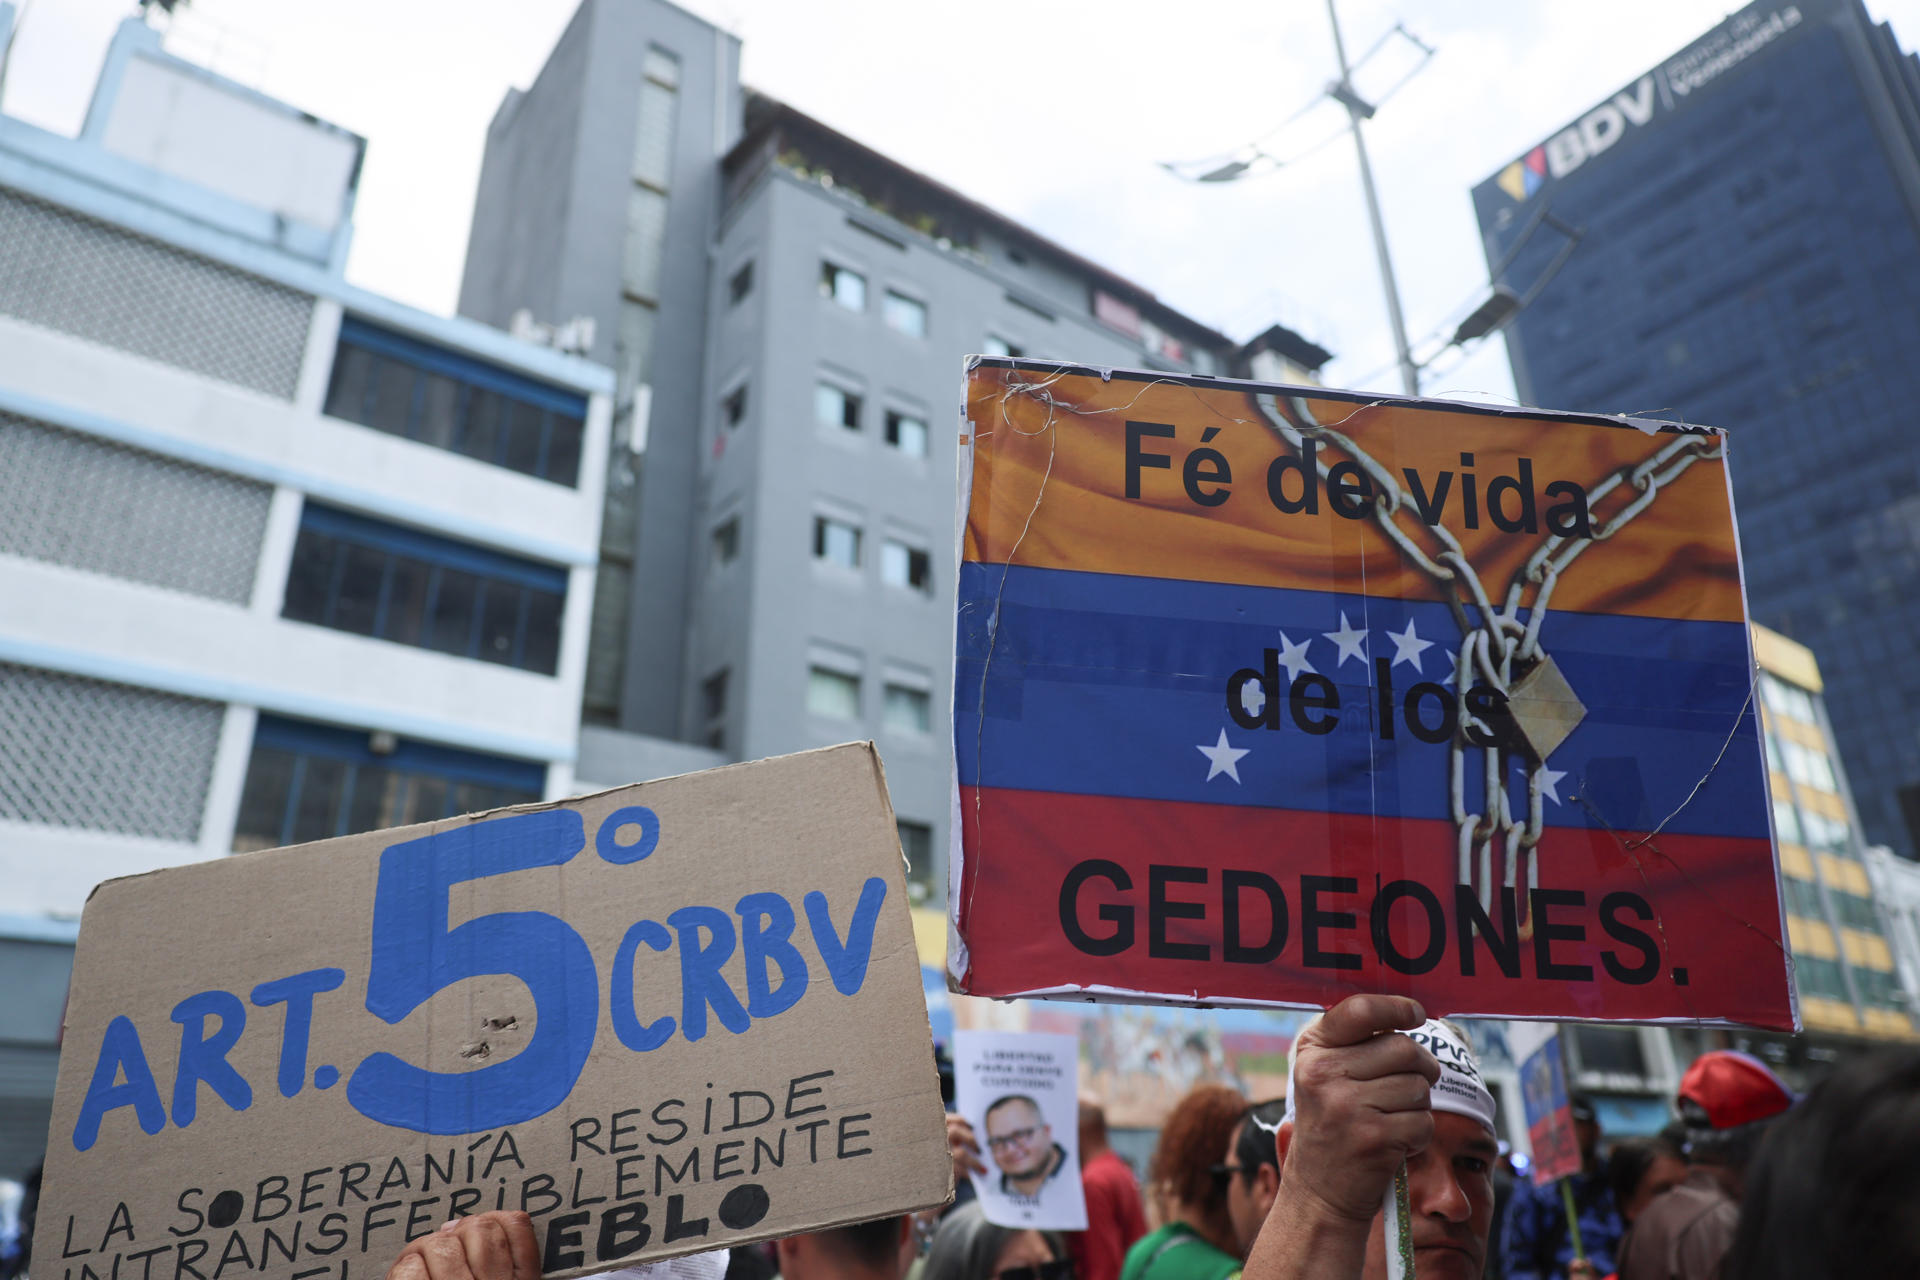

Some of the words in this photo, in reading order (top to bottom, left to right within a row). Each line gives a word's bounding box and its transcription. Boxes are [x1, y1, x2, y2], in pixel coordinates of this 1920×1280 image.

[1670, 5, 1802, 96] Venezuela
[1546, 76, 1655, 179] BDV
[1124, 420, 1232, 507] Fé
[1266, 437, 1373, 520] de
[1402, 452, 1592, 539] vida
[1225, 648, 1340, 735] de
[1376, 657, 1509, 748] los
[1058, 859, 1689, 986] GEDEONES.
[72, 967, 346, 1152] ART.
[610, 877, 887, 1052] CRBV
[1441, 1075, 1478, 1093] Libertad
[62, 1202, 135, 1258] LA
[542, 1183, 770, 1274] EBLO
